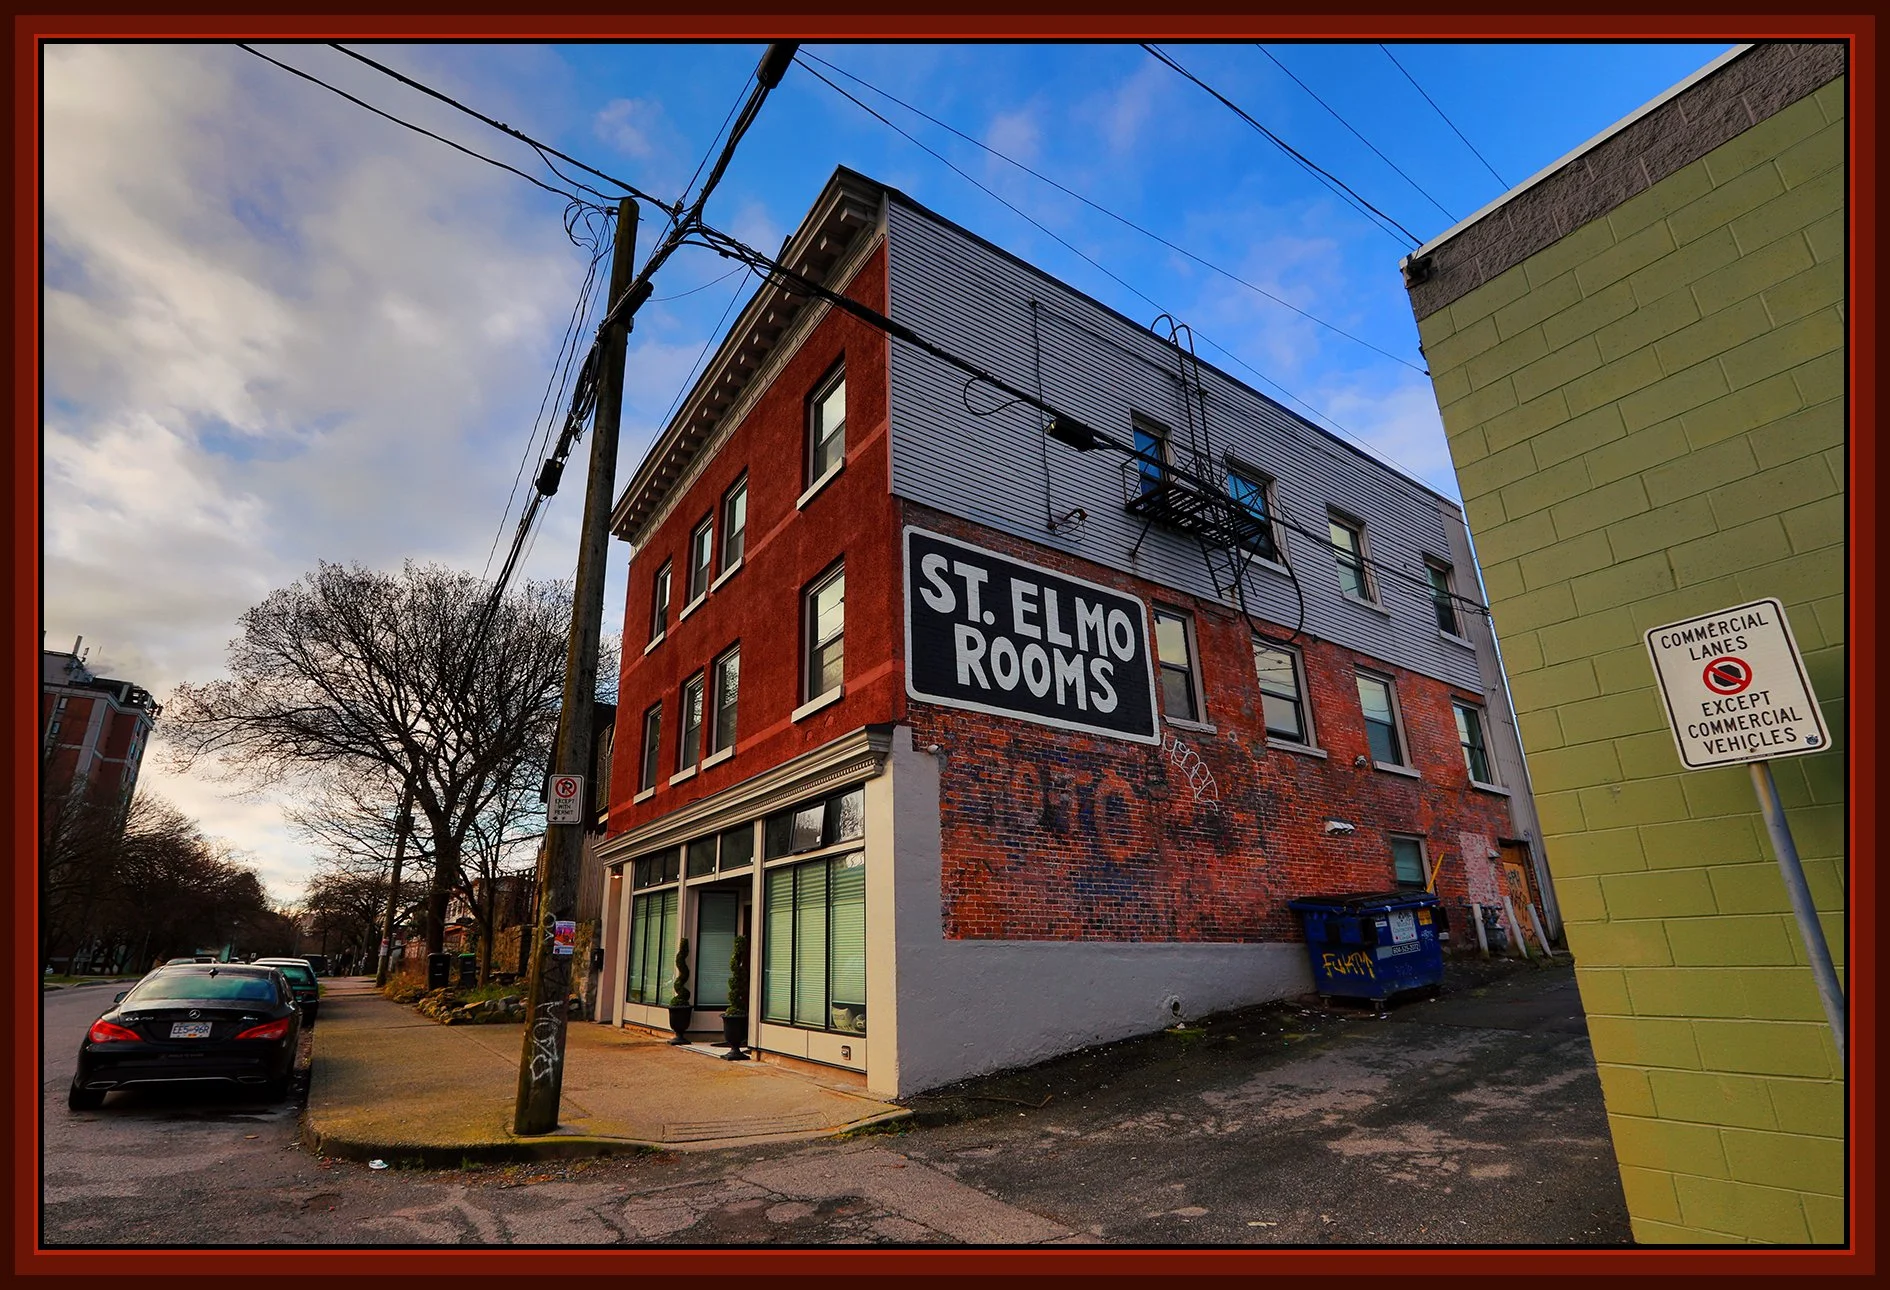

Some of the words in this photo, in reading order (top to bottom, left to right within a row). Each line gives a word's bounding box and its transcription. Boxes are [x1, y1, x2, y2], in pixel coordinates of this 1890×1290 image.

[919, 553, 996, 625] ST.
[1010, 577, 1135, 662] ELMO
[1661, 612, 1769, 649] COMMERCIAL
[1689, 635, 1748, 661] LANES
[954, 623, 1119, 713] ROOMS
[1702, 691, 1771, 717] EXCEPT
[1688, 706, 1803, 739] COMMERCIAL
[1703, 727, 1798, 755] VEHICLES
